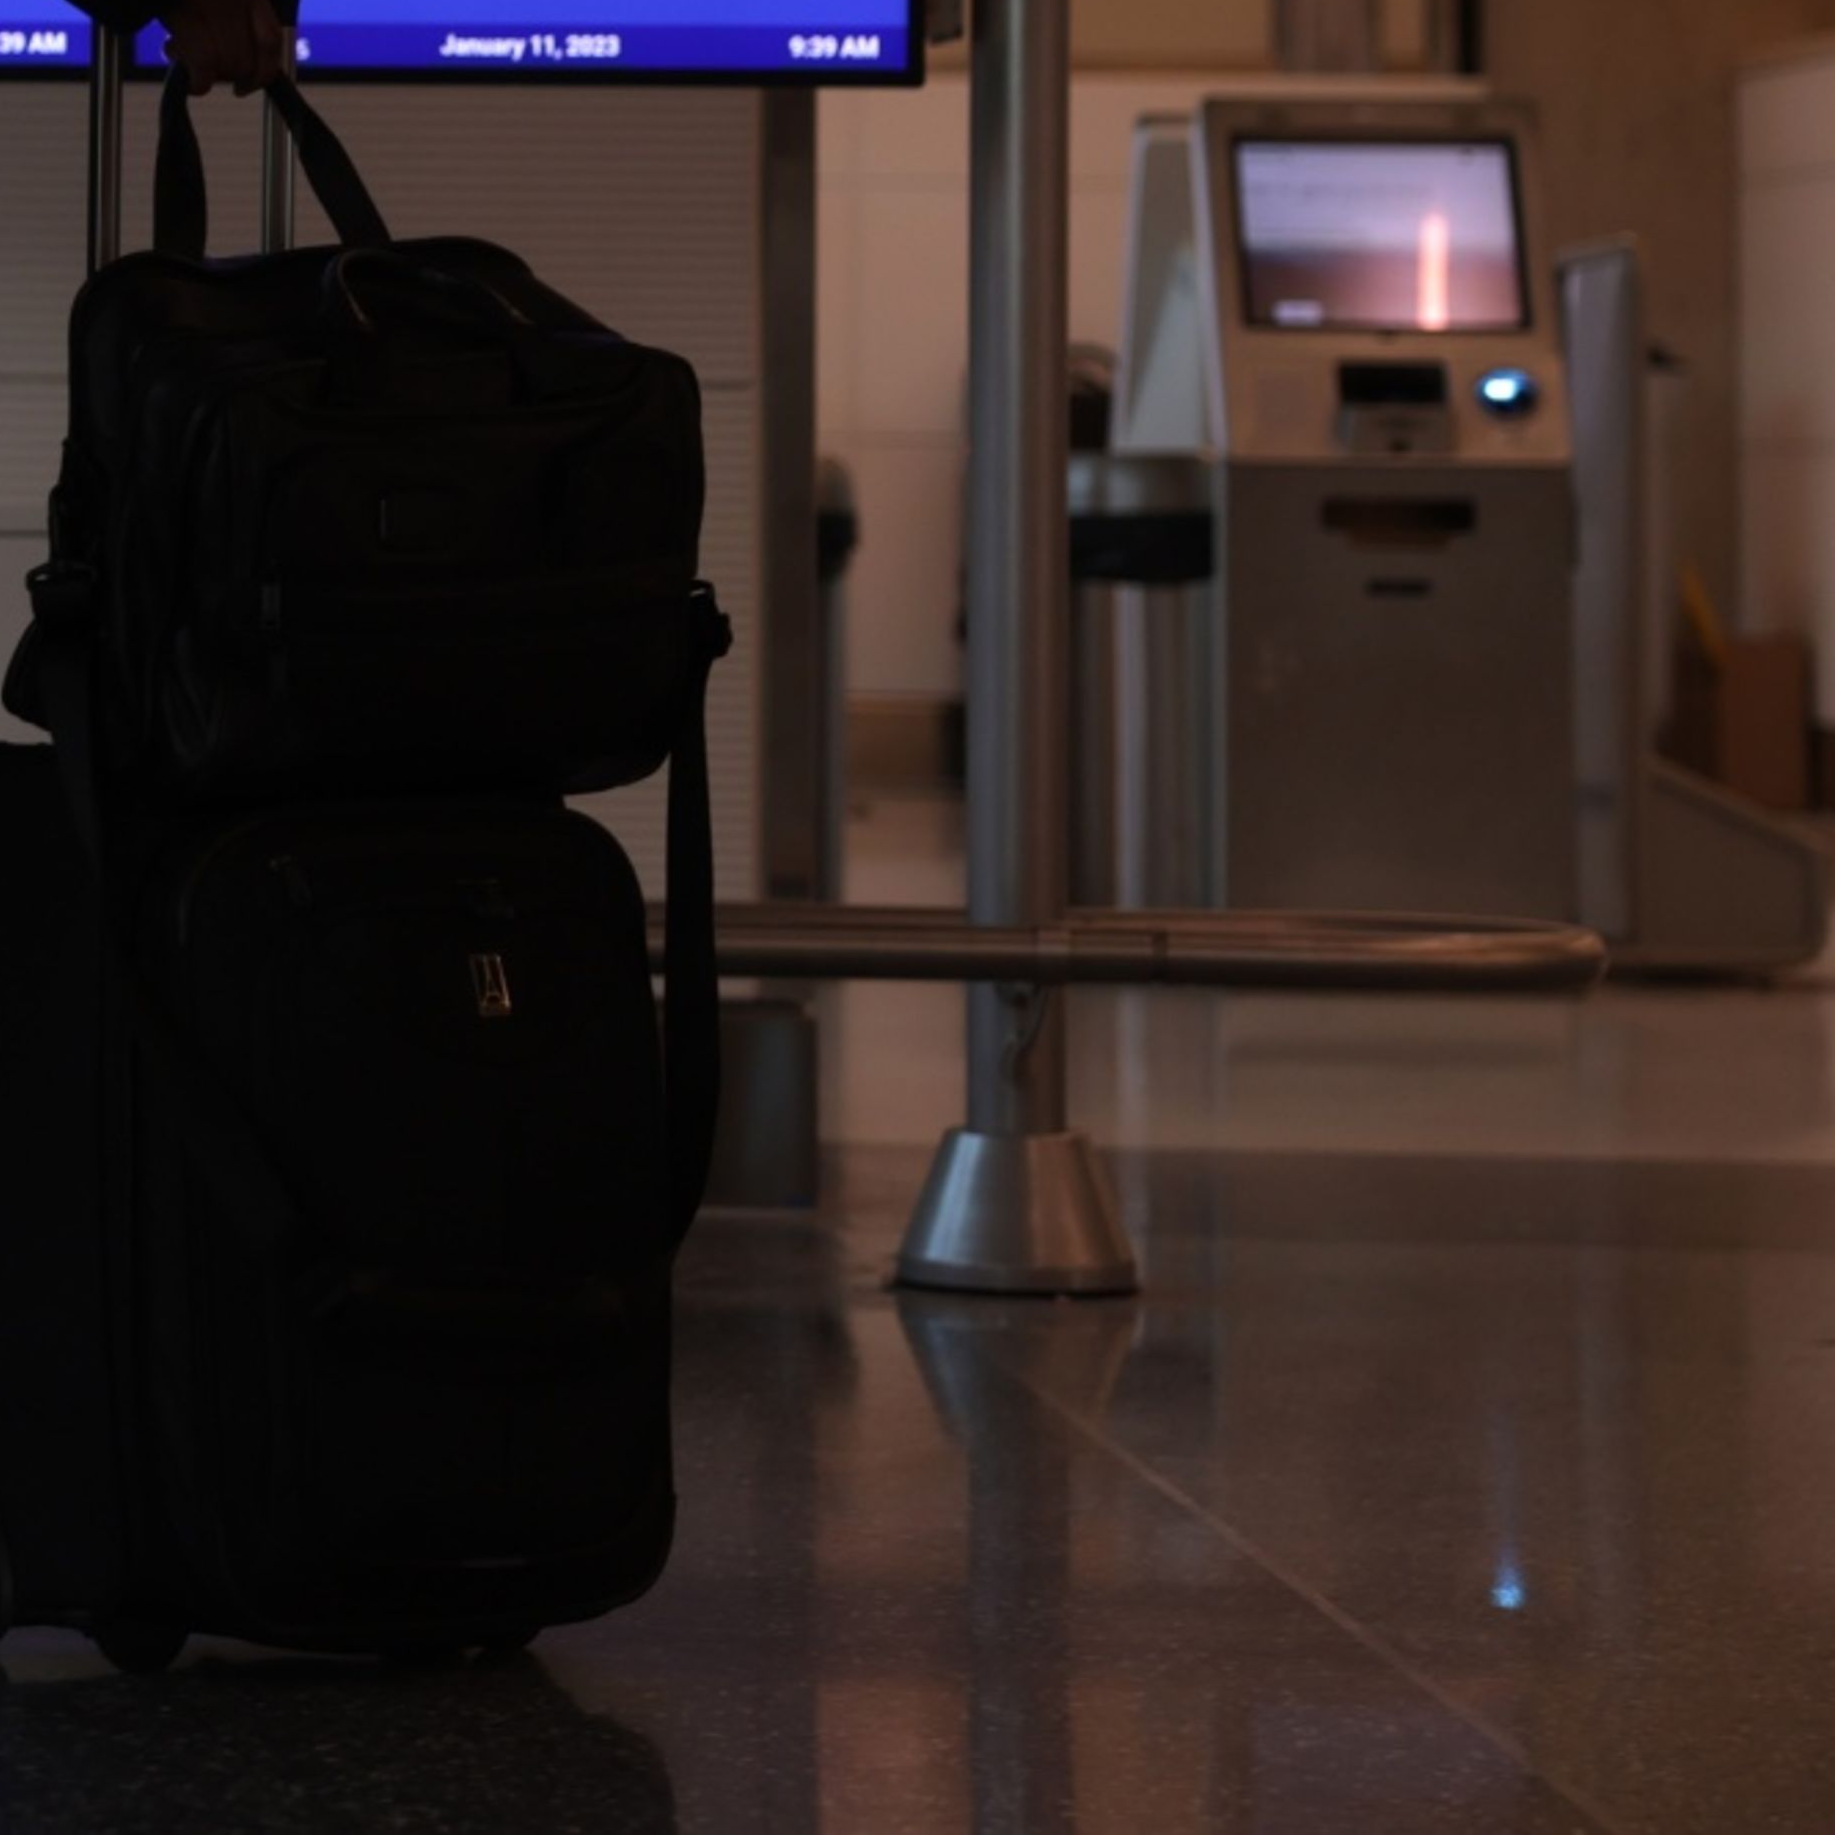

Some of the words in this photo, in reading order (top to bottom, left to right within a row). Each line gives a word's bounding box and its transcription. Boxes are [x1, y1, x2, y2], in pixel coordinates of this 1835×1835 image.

[27, 31, 68, 54] AM
[438, 34, 527, 61] January
[529, 34, 564, 59] 11,
[564, 34, 621, 57] 2023
[787, 35, 839, 58] 9:39
[839, 35, 881, 58] AM
